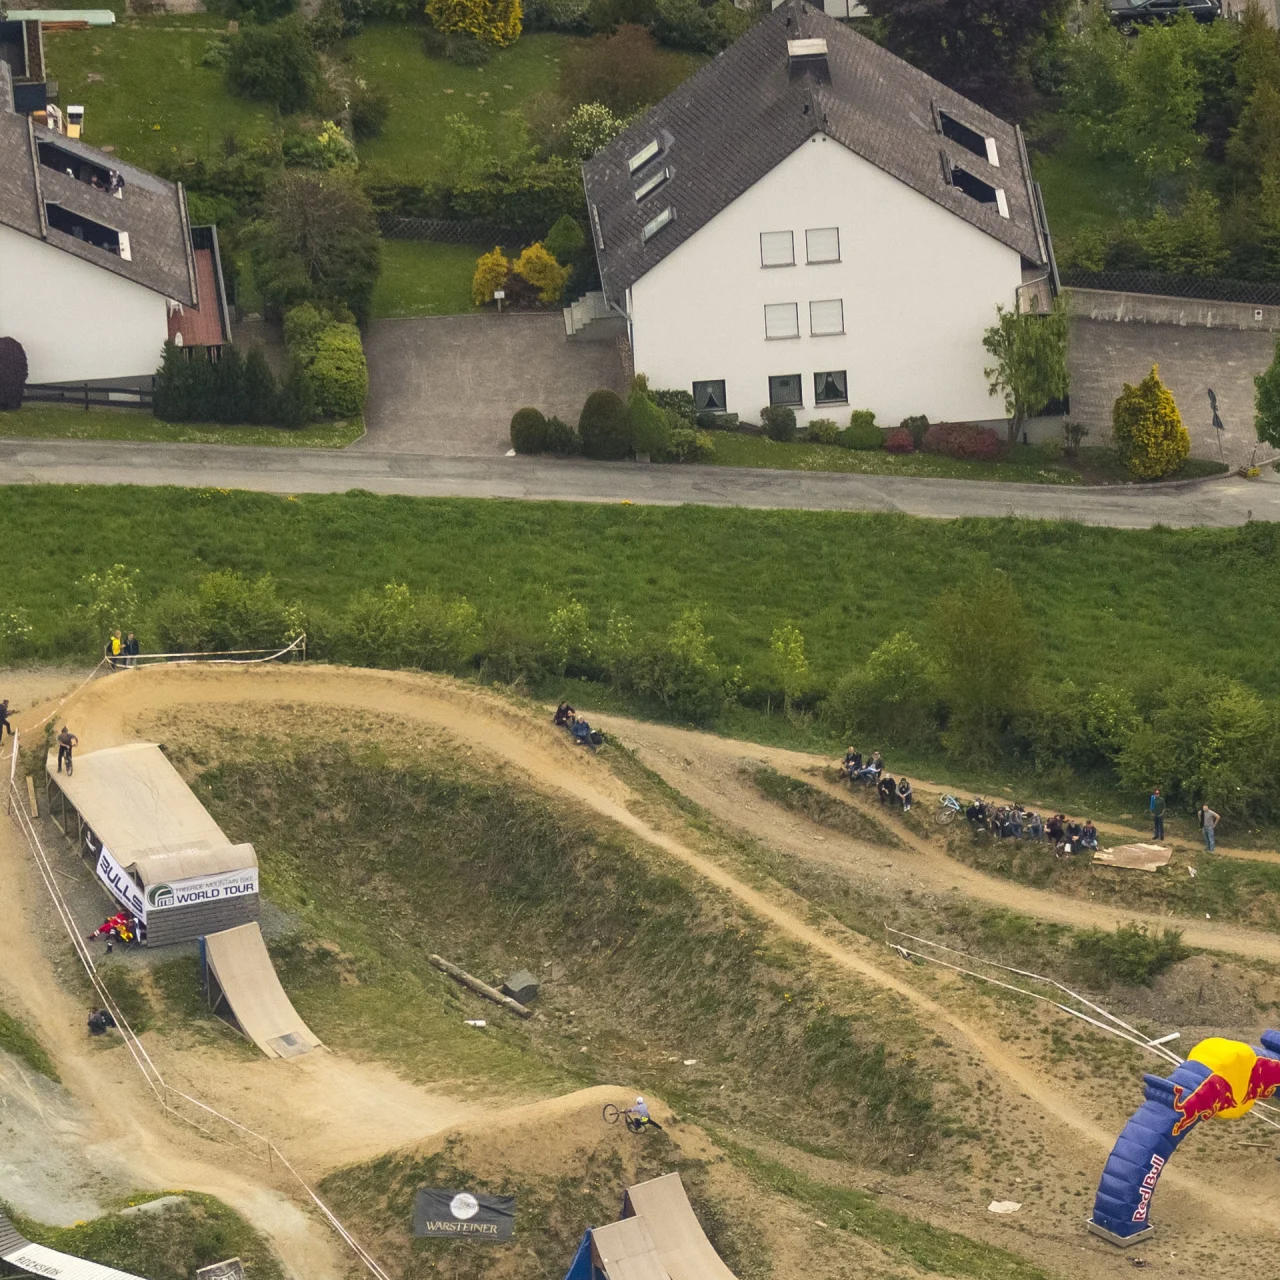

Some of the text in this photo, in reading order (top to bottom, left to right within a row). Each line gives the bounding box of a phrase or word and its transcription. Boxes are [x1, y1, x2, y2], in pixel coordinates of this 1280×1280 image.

[99, 855, 143, 915] BULLS
[176, 883, 254, 904] WORLD TOUR
[1131, 1154, 1165, 1222] Red Bull
[426, 1221, 498, 1234] WARSTEINER
